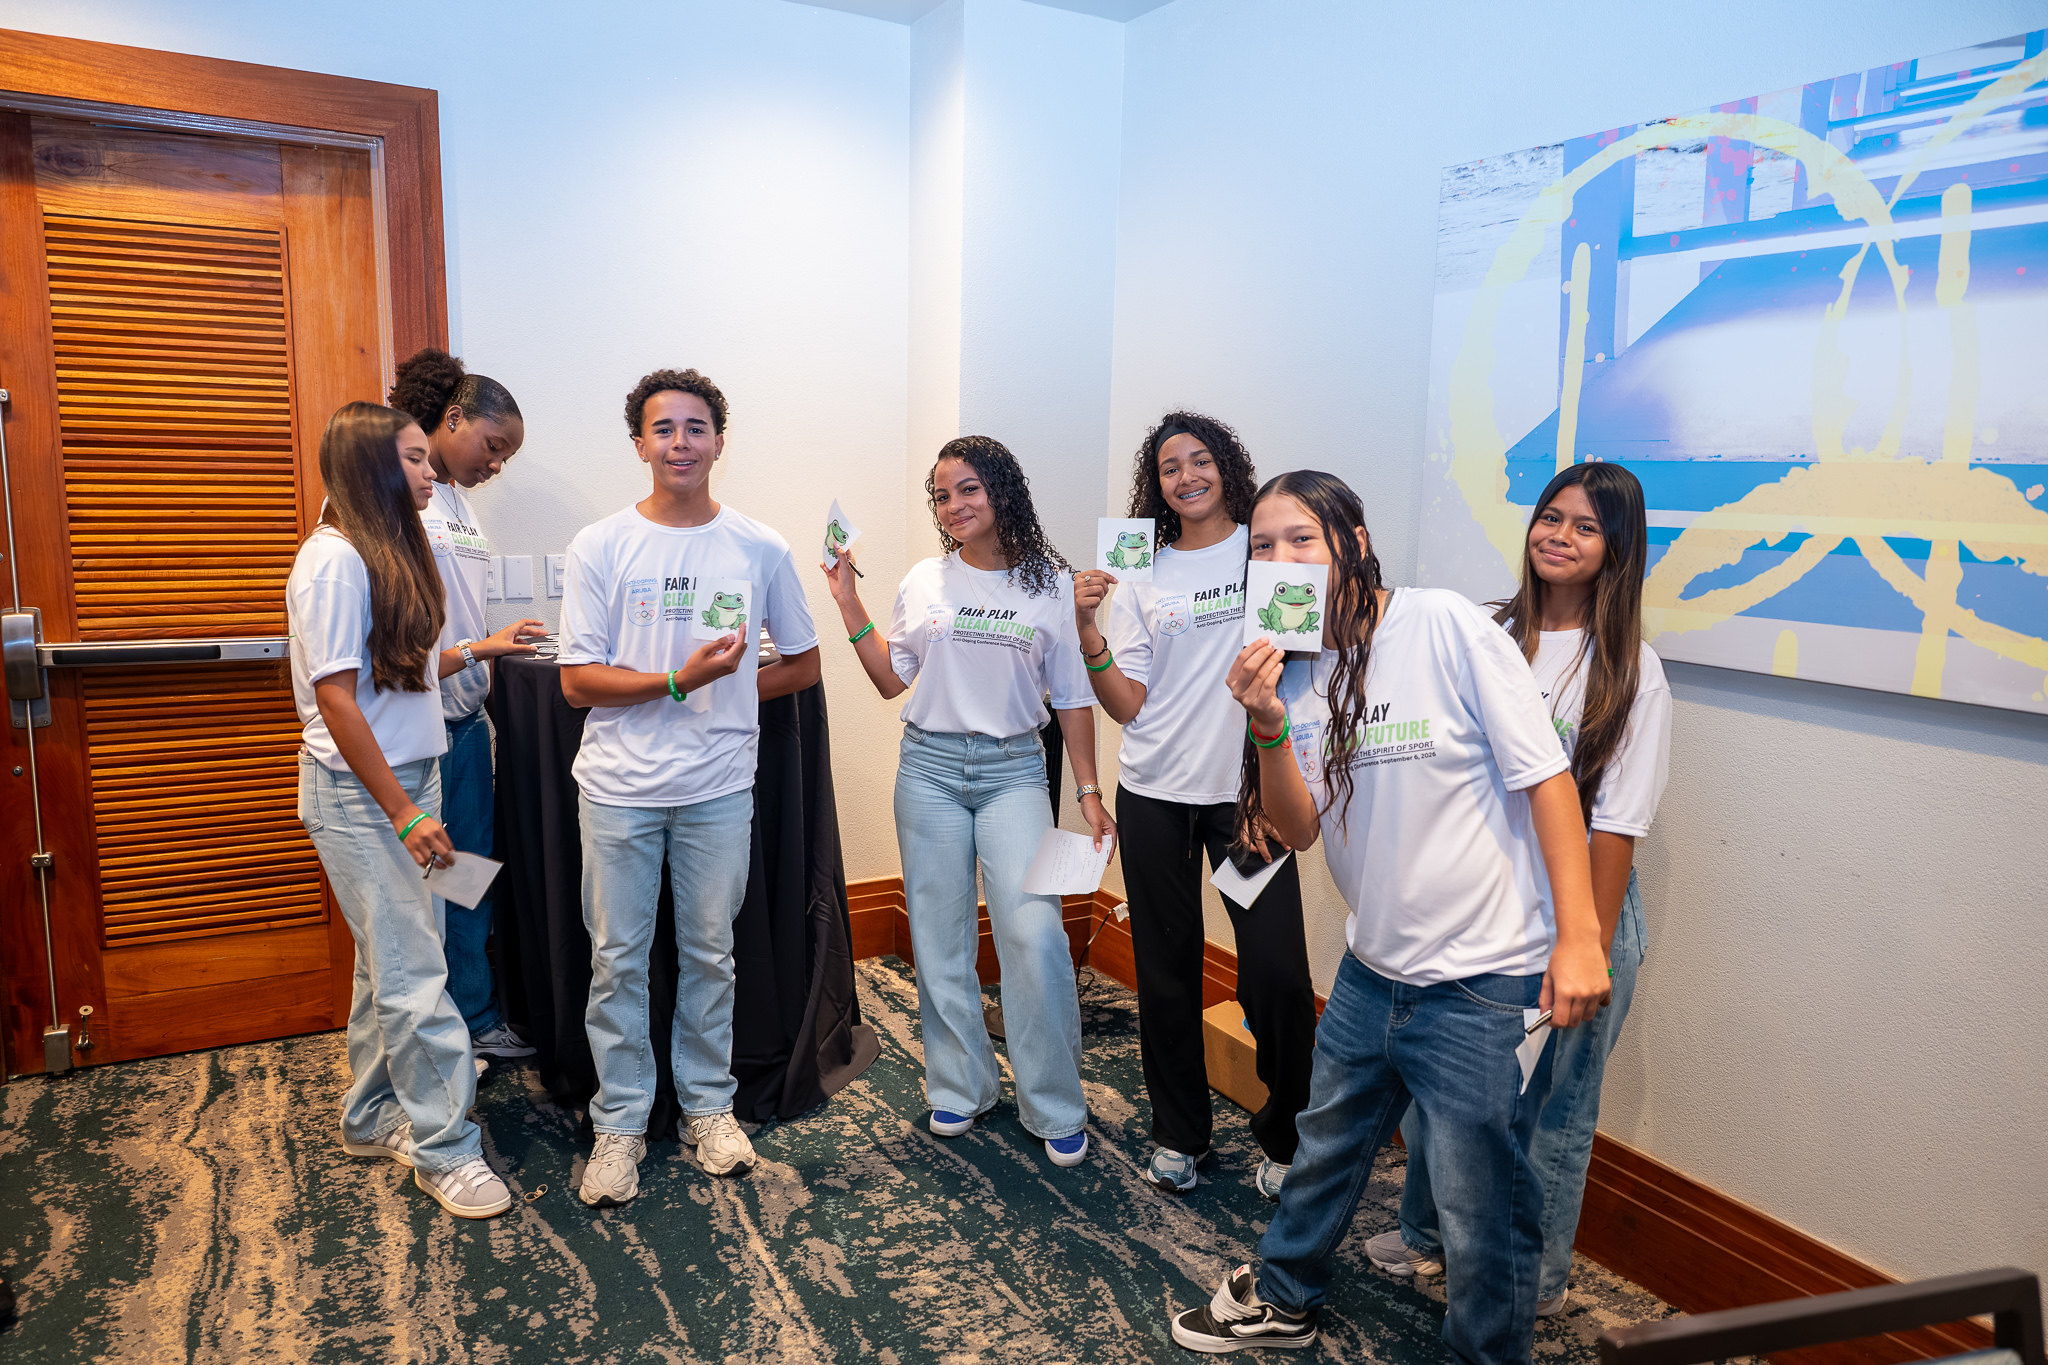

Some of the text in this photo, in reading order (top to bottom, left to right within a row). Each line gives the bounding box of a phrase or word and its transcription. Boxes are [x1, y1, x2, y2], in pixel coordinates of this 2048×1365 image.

[446, 521, 462, 534] FAIR
[462, 525, 479, 537] PLAY
[451, 533, 473, 546] CLEAN
[665, 577, 689, 591] FAIR
[1194, 587, 1220, 602] FAIR
[1225, 581, 1245, 596] PLA
[958, 606, 985, 617] FAIR
[987, 609, 1017, 620] PLAY
[1193, 596, 1232, 614] CLEAN
[1195, 609, 1229, 621] PROTECTING
[953, 616, 1036, 641] CLEAN FUTURE
[1196, 619, 1222, 628] Anti-Doping
[952, 629, 984, 637] PROTECTING
[1366, 718, 1430, 747] FUTURE
[1360, 740, 1434, 757] THE SPIRIT OF SPORT
[1353, 759, 1379, 770] Conference
[1380, 755, 1413, 766] September
[1421, 751, 1437, 759] 2026
